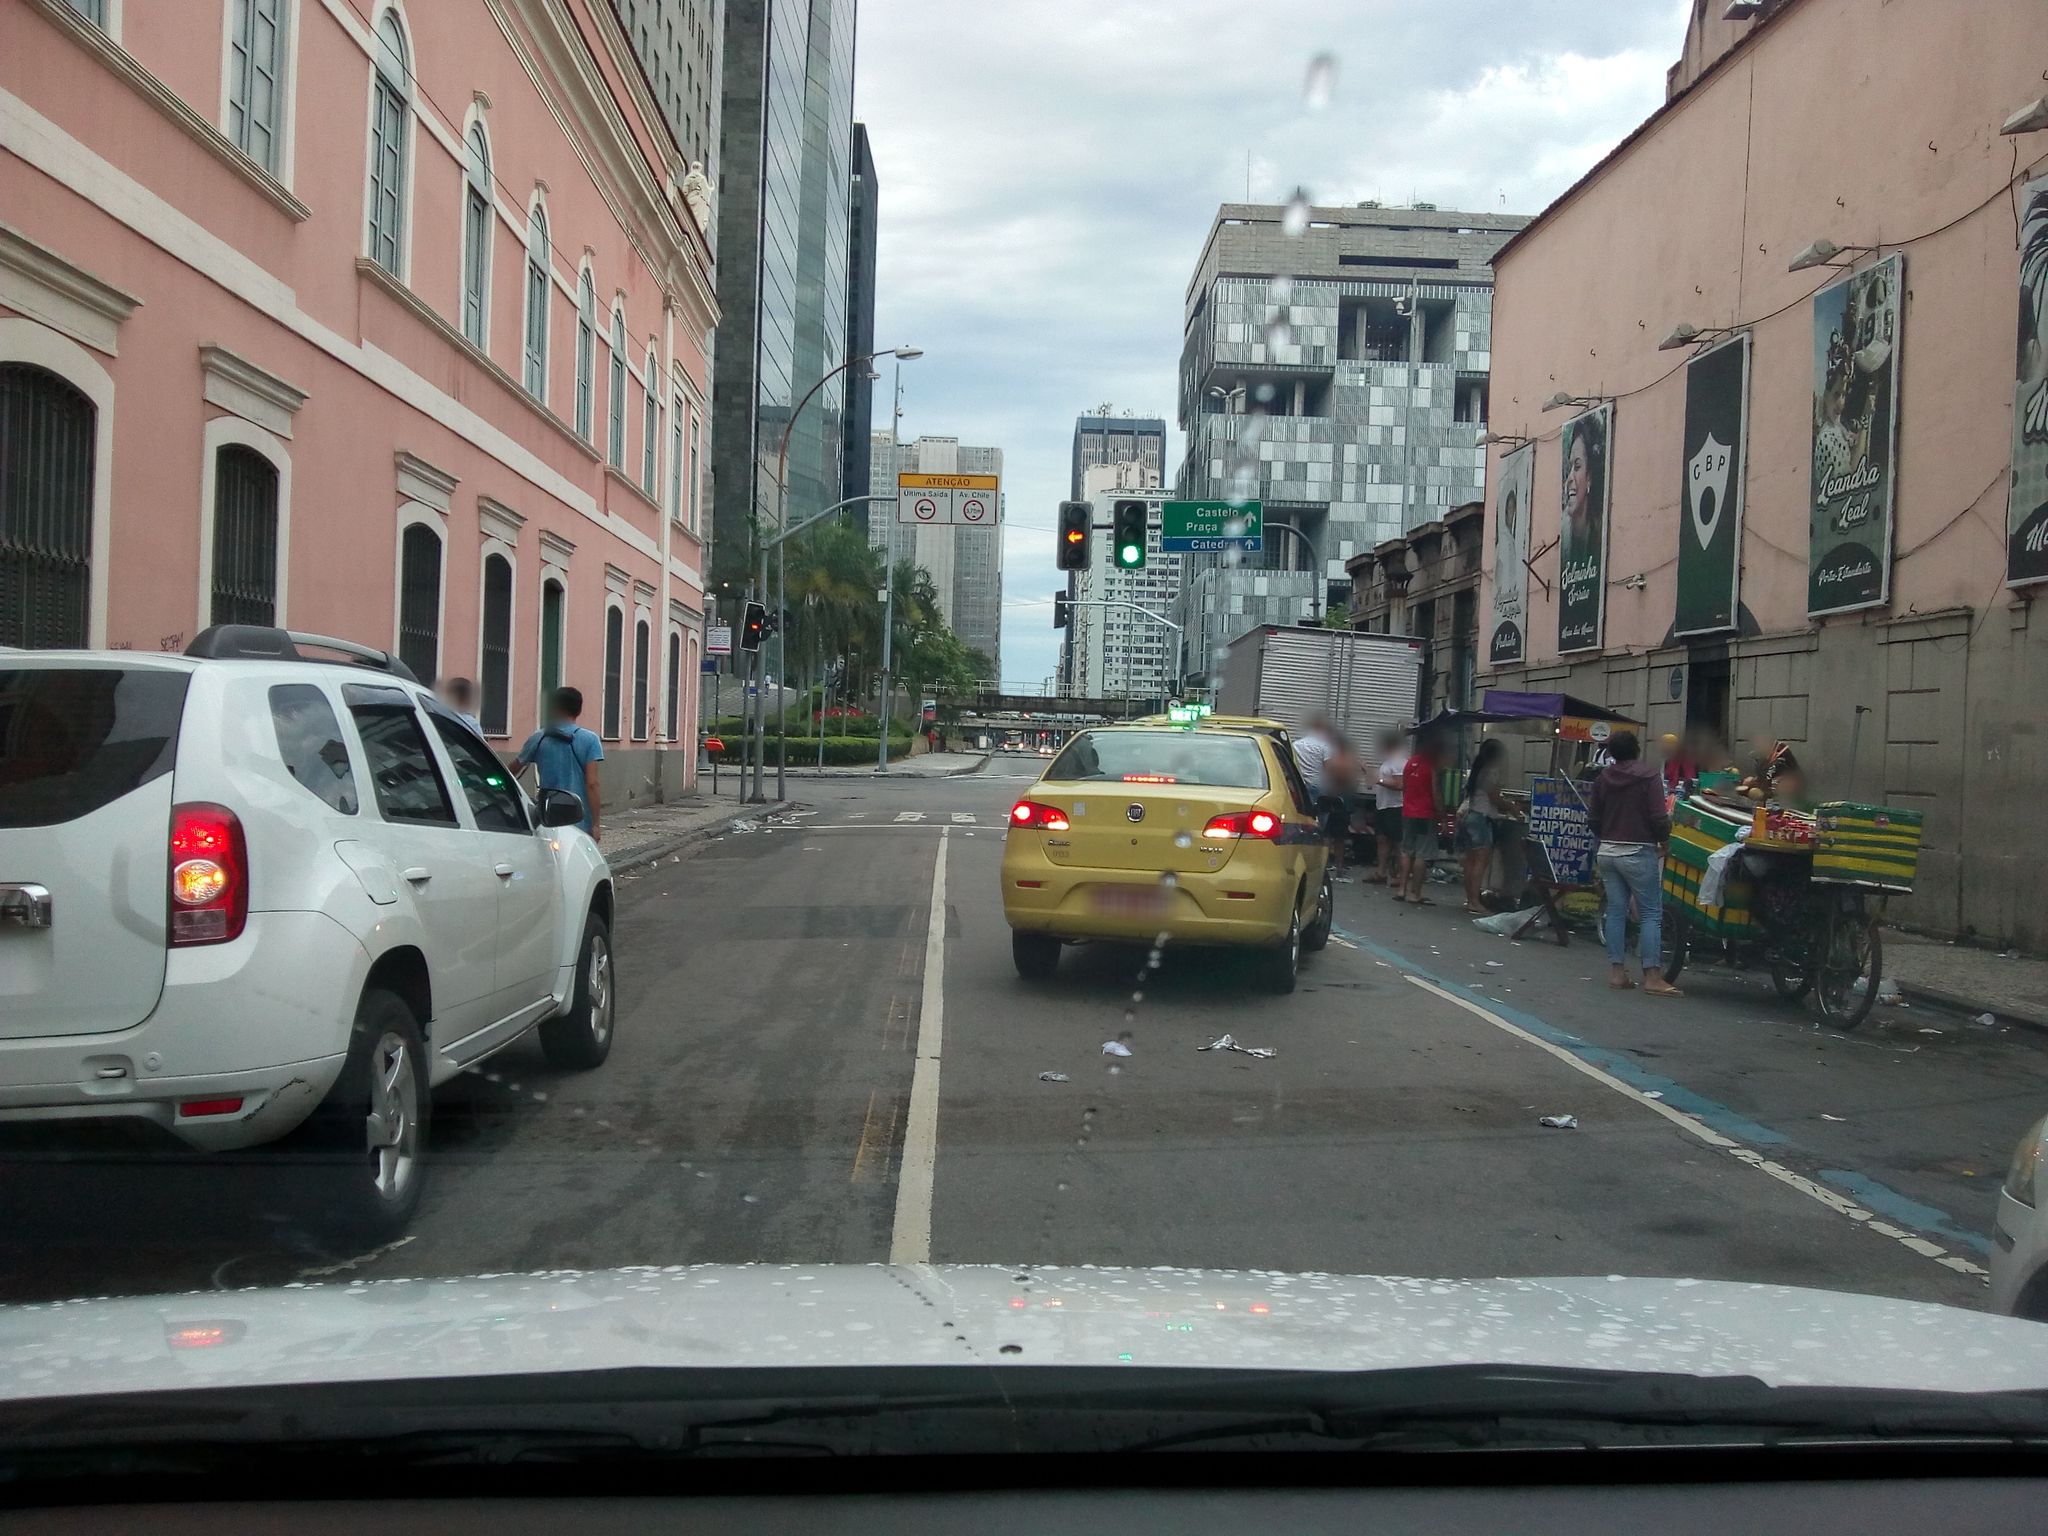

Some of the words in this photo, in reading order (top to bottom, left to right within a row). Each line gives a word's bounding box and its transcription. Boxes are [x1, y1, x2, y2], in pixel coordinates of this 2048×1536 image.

[1816, 455, 1880, 505] Leandra
[1196, 507, 1239, 517] Castelo
[1839, 492, 1870, 529] Leal
[1186, 522, 1218, 533] Praça
[1191, 540, 1238, 549] Catedrl
[1531, 805, 1588, 823] CAIPIRINH
